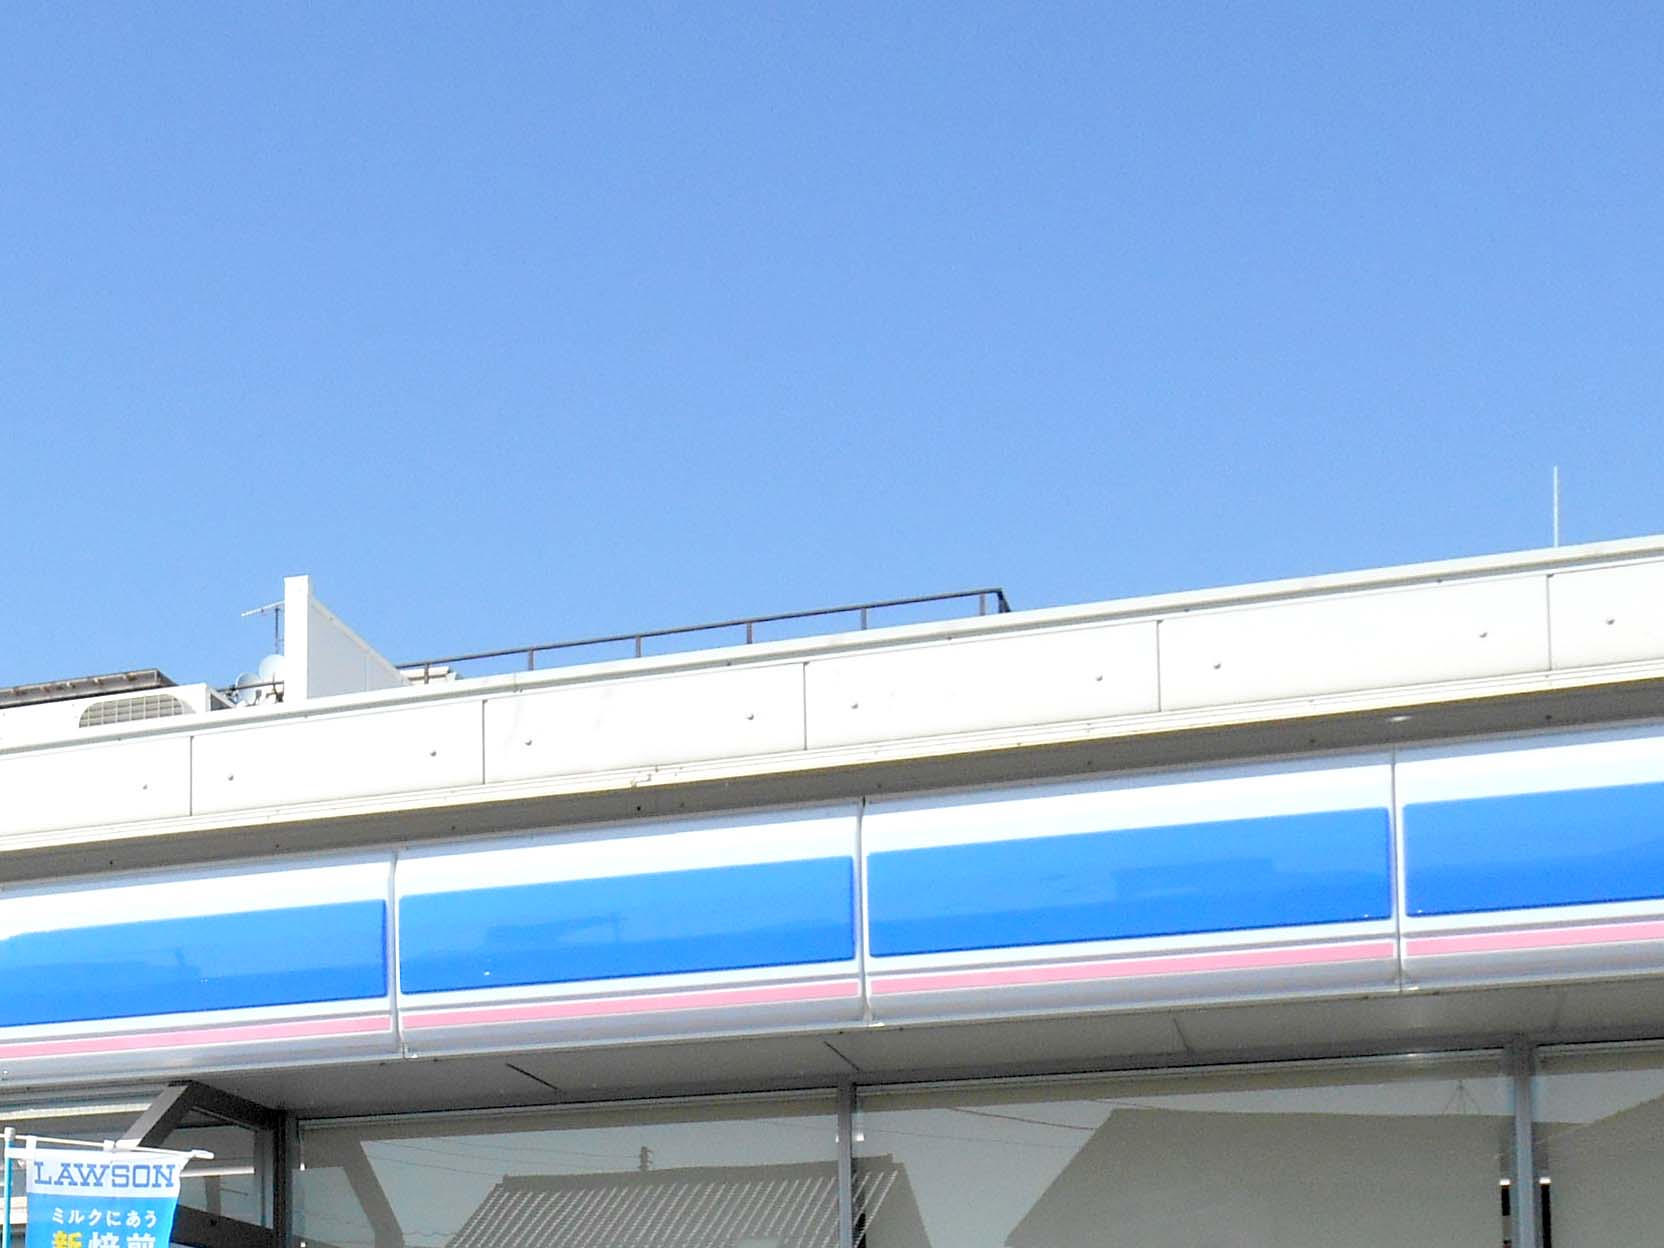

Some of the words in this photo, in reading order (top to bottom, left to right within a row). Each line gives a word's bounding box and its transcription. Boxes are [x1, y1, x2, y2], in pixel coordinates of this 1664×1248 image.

[34, 1161, 176, 1188] LAWSON
[52, 1207, 157, 1228] ミルクにあう
